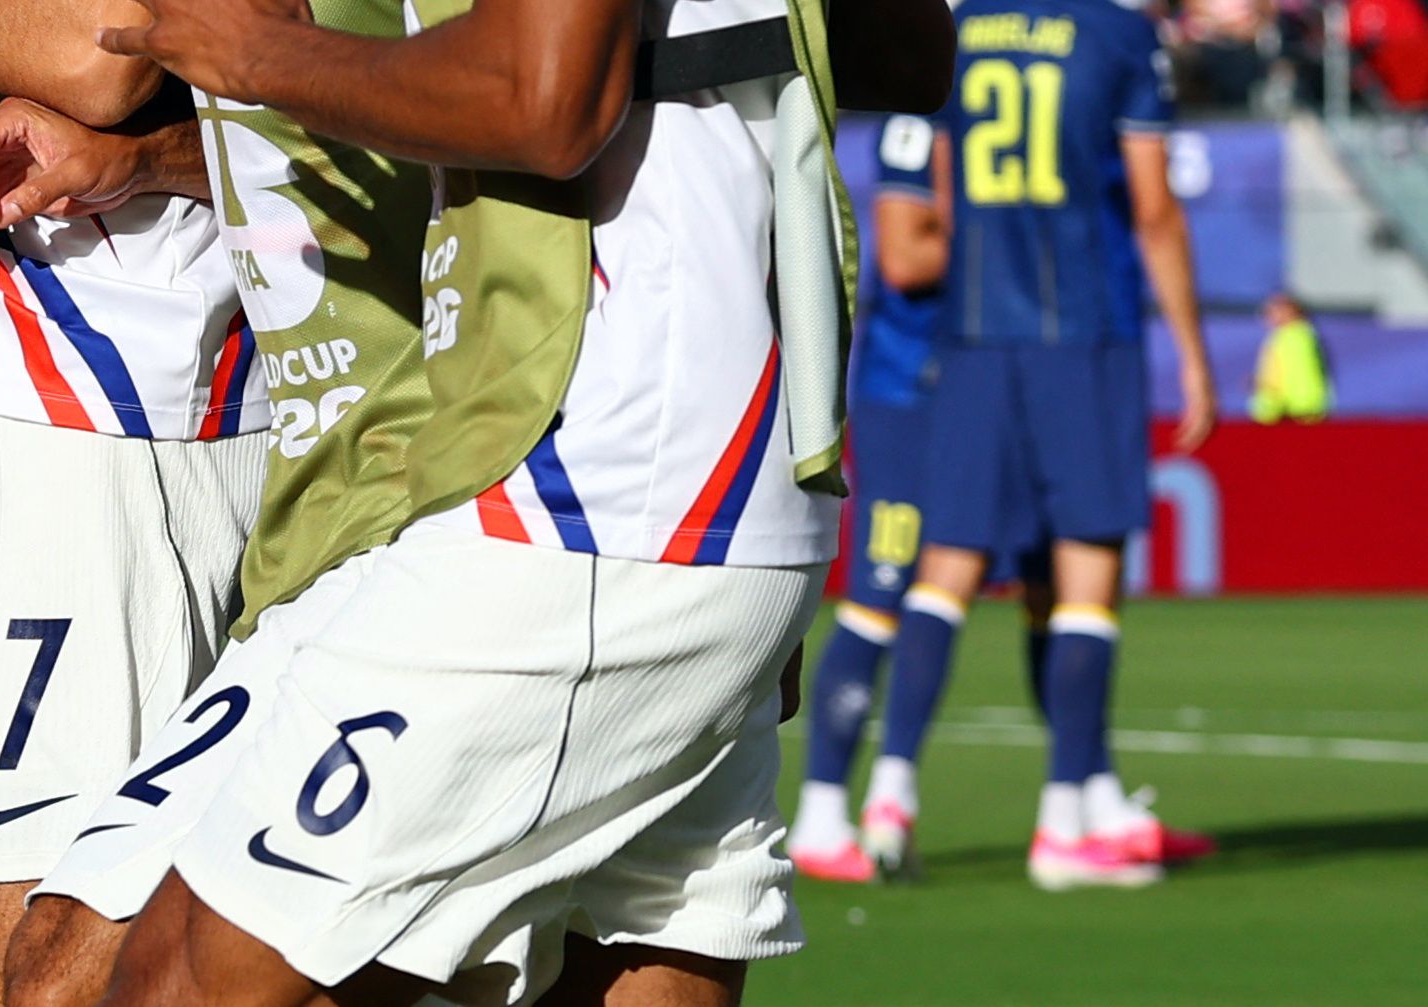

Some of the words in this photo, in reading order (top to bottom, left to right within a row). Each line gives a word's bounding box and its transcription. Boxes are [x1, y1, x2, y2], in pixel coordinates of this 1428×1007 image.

[961, 58, 1067, 205] 21
[281, 338, 357, 386] CUP
[116, 684, 251, 808] 2
[295, 709, 409, 837] 6
